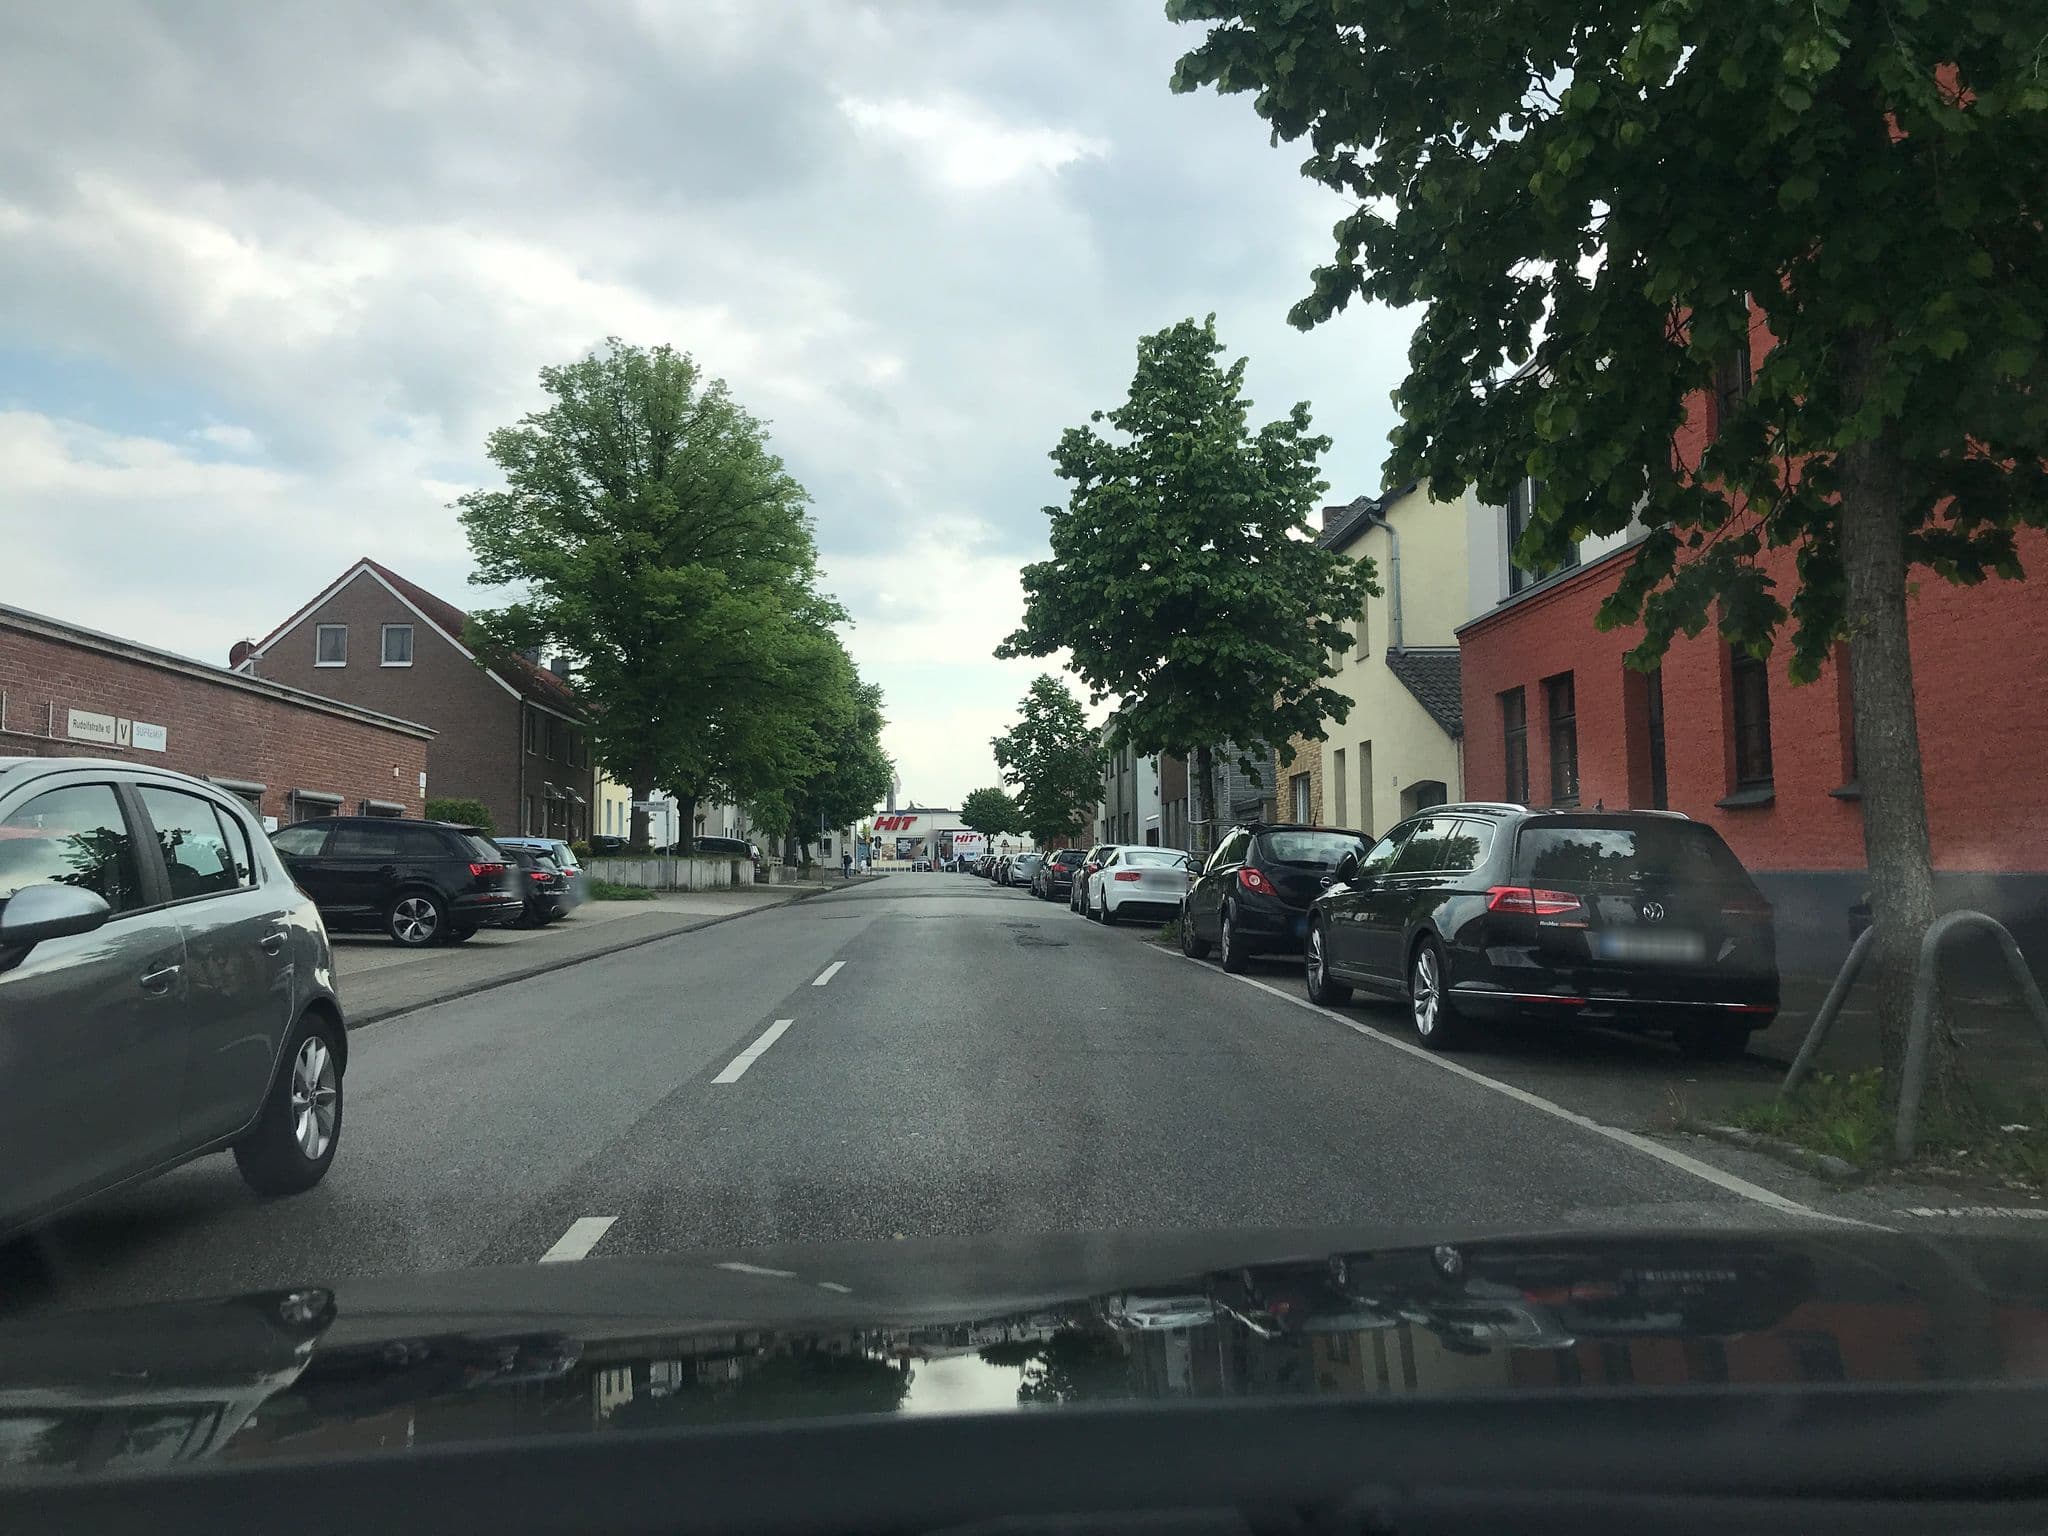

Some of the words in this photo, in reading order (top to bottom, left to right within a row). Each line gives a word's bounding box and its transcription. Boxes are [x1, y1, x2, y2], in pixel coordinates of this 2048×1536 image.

[73, 718, 104, 733] Rudolfstraße
[120, 724, 128, 740] V
[873, 816, 918, 831] HIT
[955, 834, 977, 843] HIT
